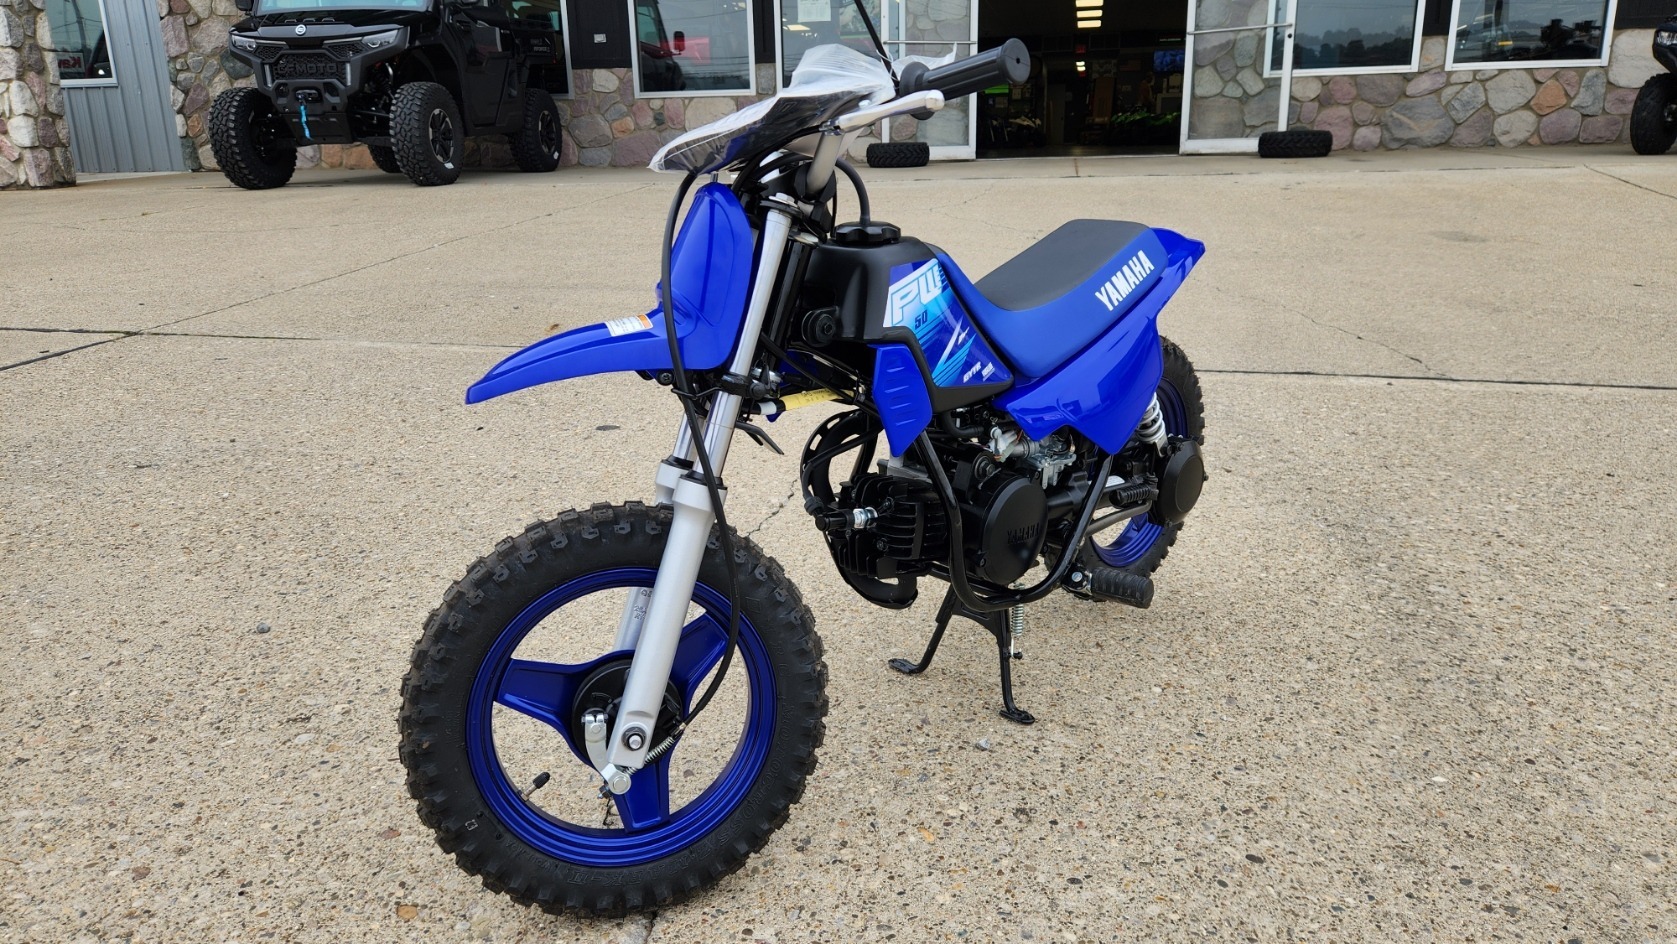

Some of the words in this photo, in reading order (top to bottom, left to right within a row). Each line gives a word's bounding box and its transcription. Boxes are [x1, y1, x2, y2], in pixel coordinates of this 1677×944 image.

[891, 262, 943, 326] PW
[1094, 250, 1155, 311] YAMAHA
[915, 310, 928, 329] 50
[1007, 522, 1040, 544] YAMAHA
